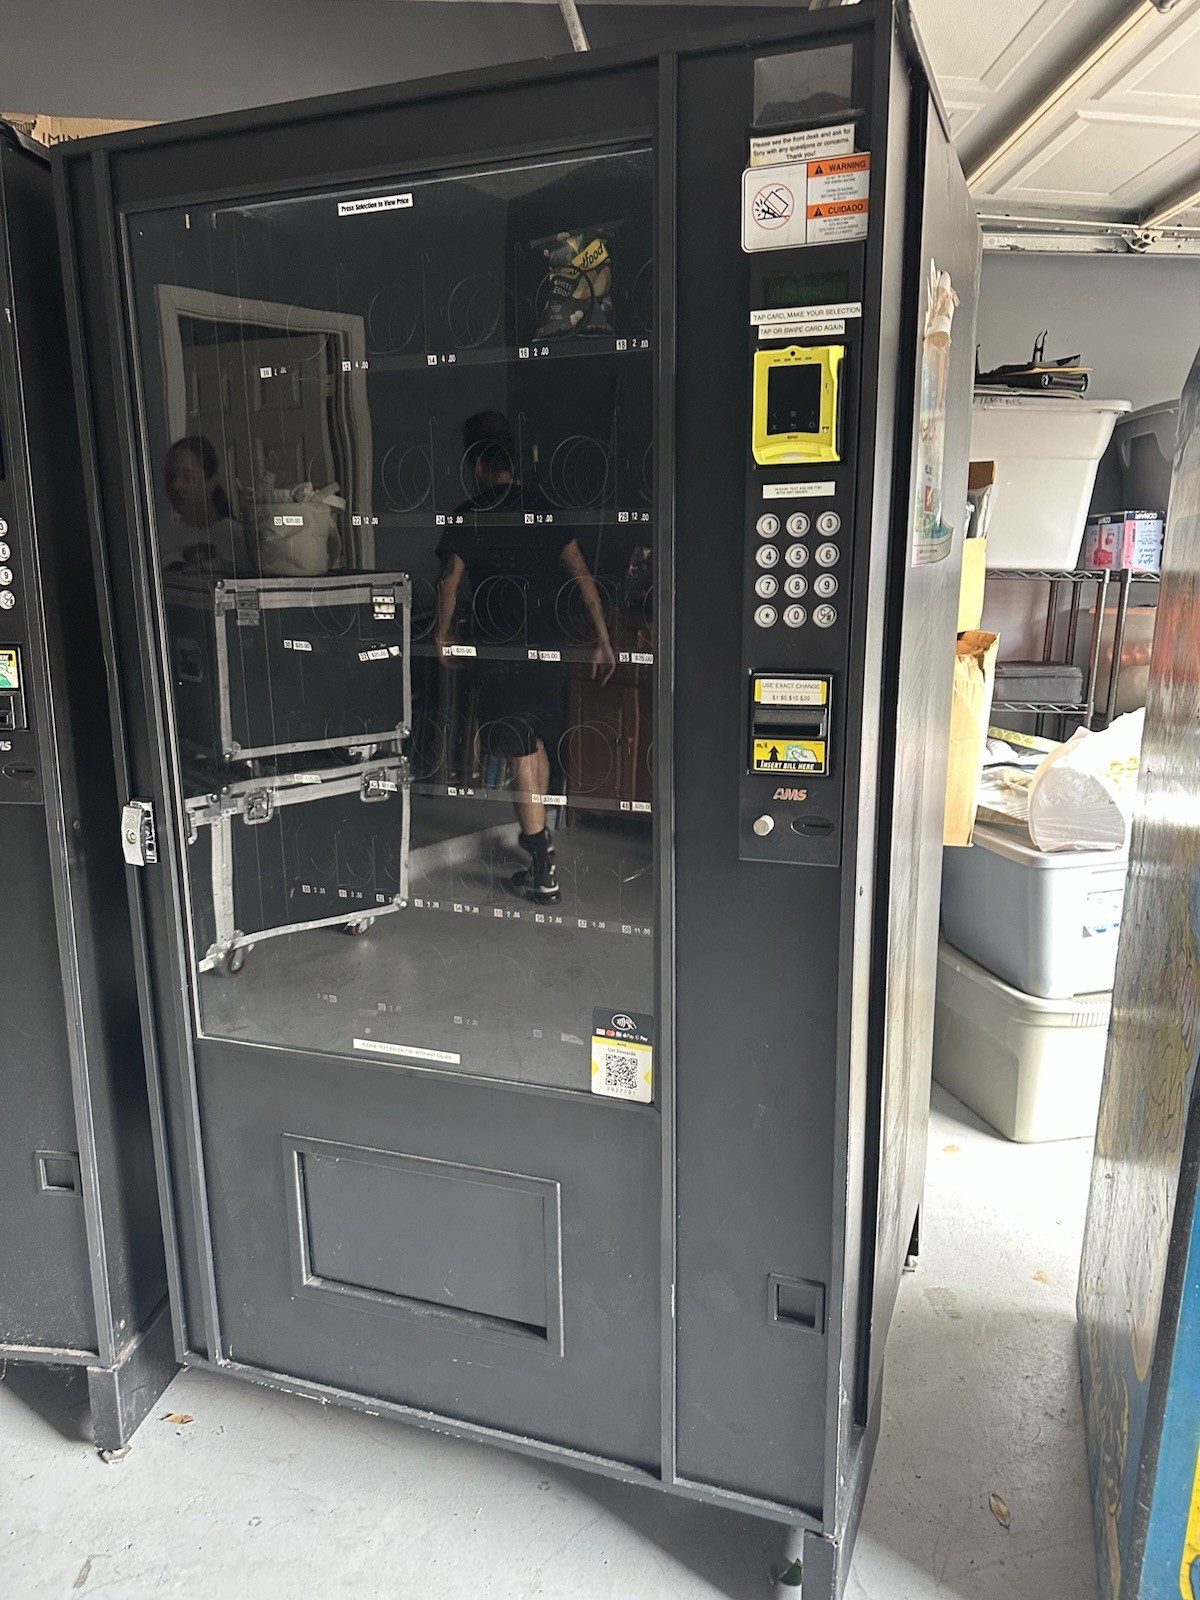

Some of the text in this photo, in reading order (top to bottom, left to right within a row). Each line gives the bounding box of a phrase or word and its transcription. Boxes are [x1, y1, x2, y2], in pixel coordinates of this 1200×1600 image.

[790, 142, 815, 151] questions
[829, 160, 866, 171] WARNING
[356, 202, 376, 210] Selection
[828, 204, 864, 214] CUIDADO
[826, 306, 860, 315] SELECTION
[618, 338, 648, 348] 18 2 .00
[534, 348, 538, 356] 2
[540, 347, 549, 356] .00
[631, 512, 638, 520] 12
[760, 760, 782, 768] INSERT
[773, 788, 807, 801] AMS
